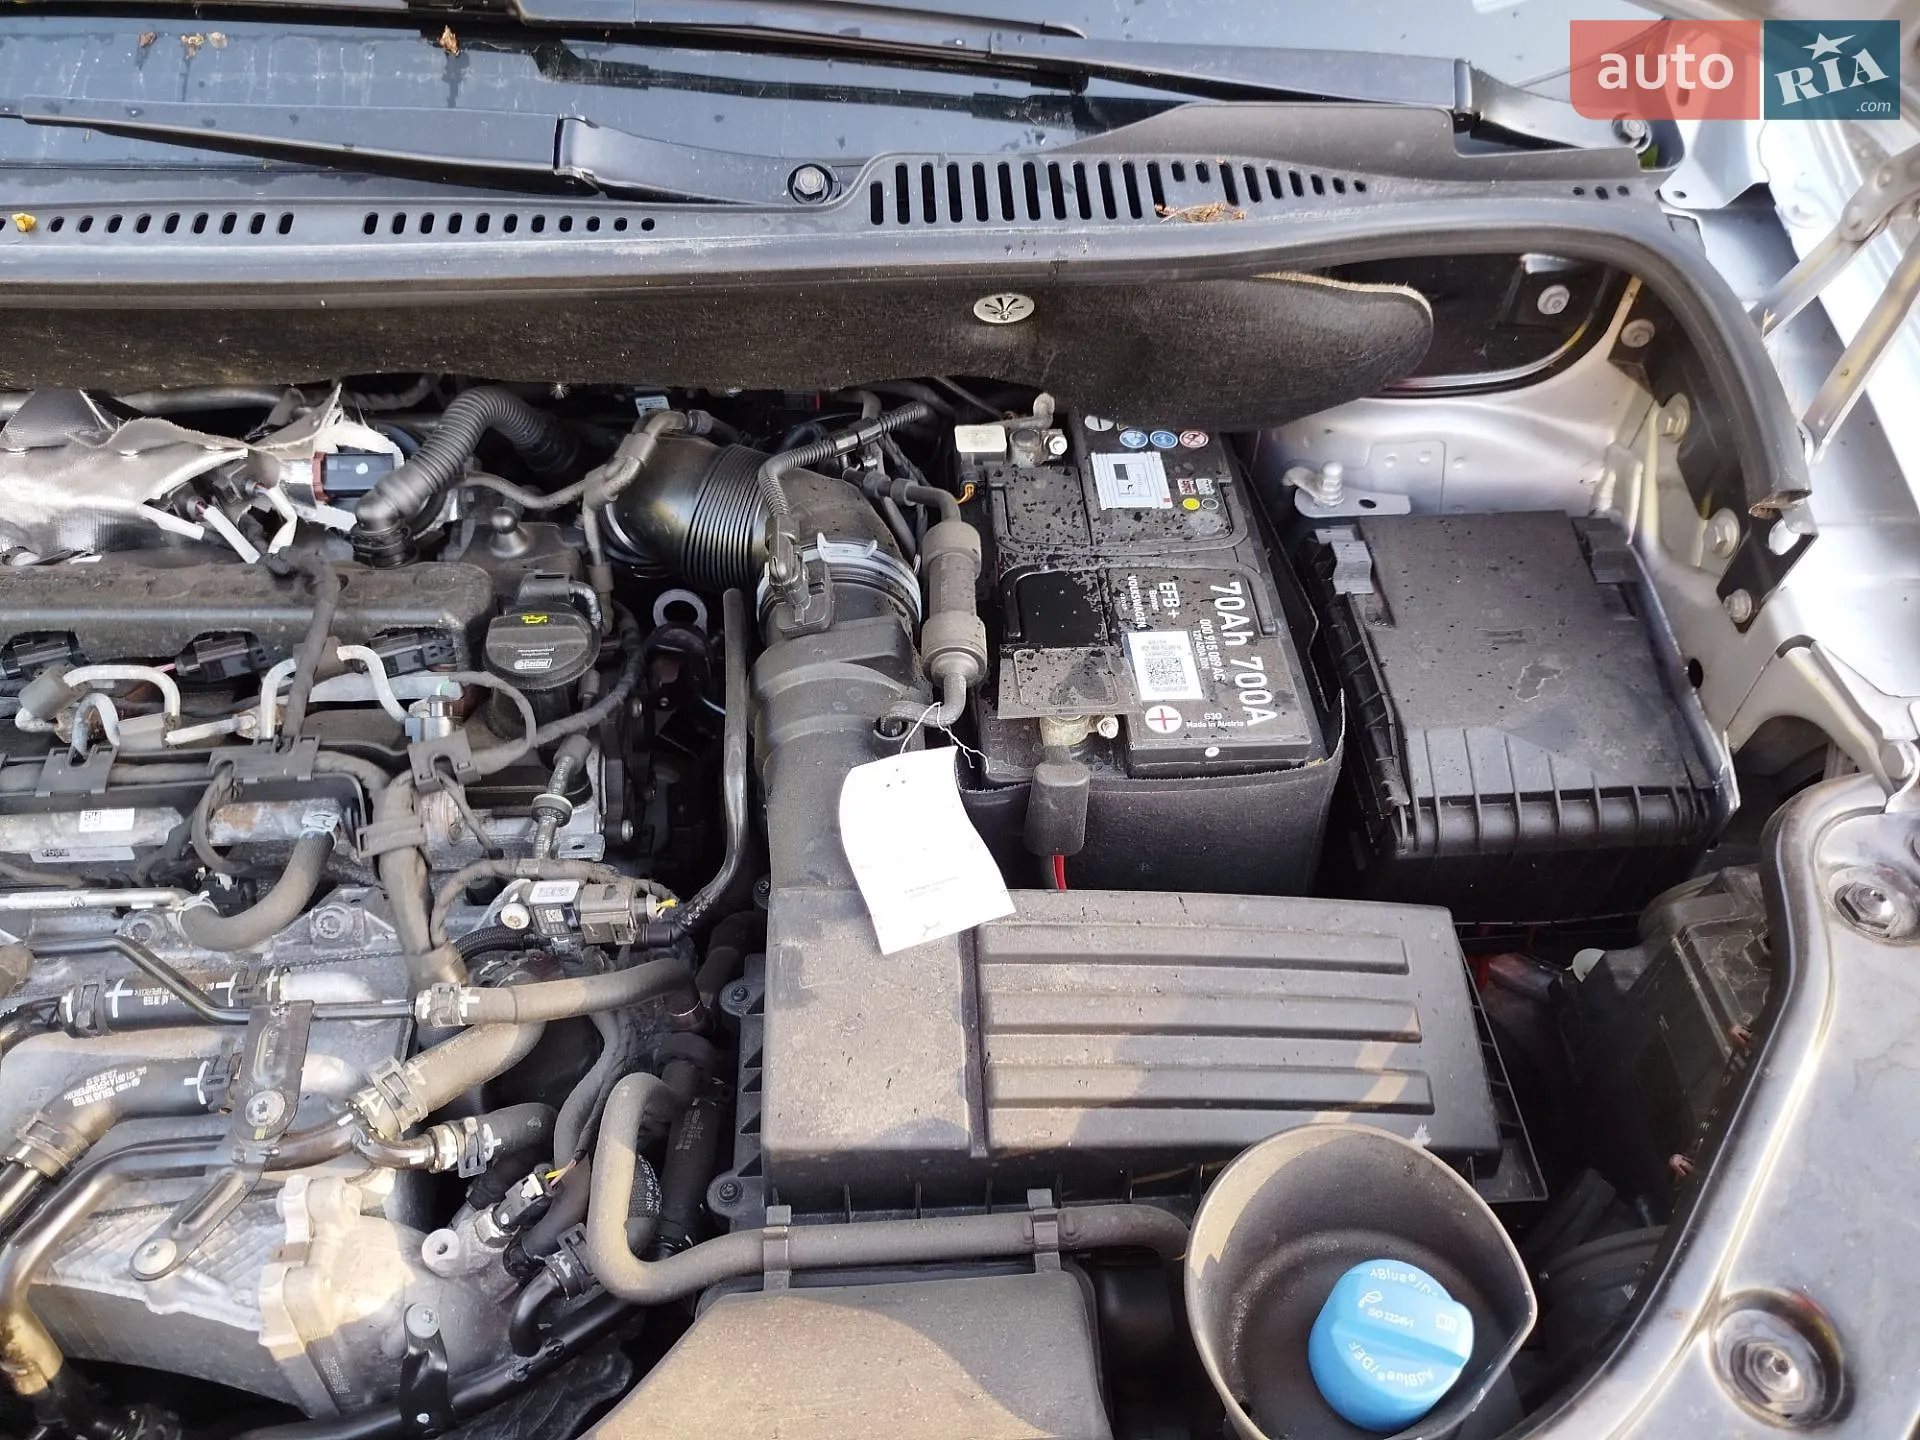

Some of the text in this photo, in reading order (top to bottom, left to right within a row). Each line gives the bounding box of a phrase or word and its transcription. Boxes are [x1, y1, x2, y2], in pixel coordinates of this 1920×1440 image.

[1128, 575, 1147, 628] VOLKSWAGEN
[1209, 581, 1278, 727] 70Ah 700A
